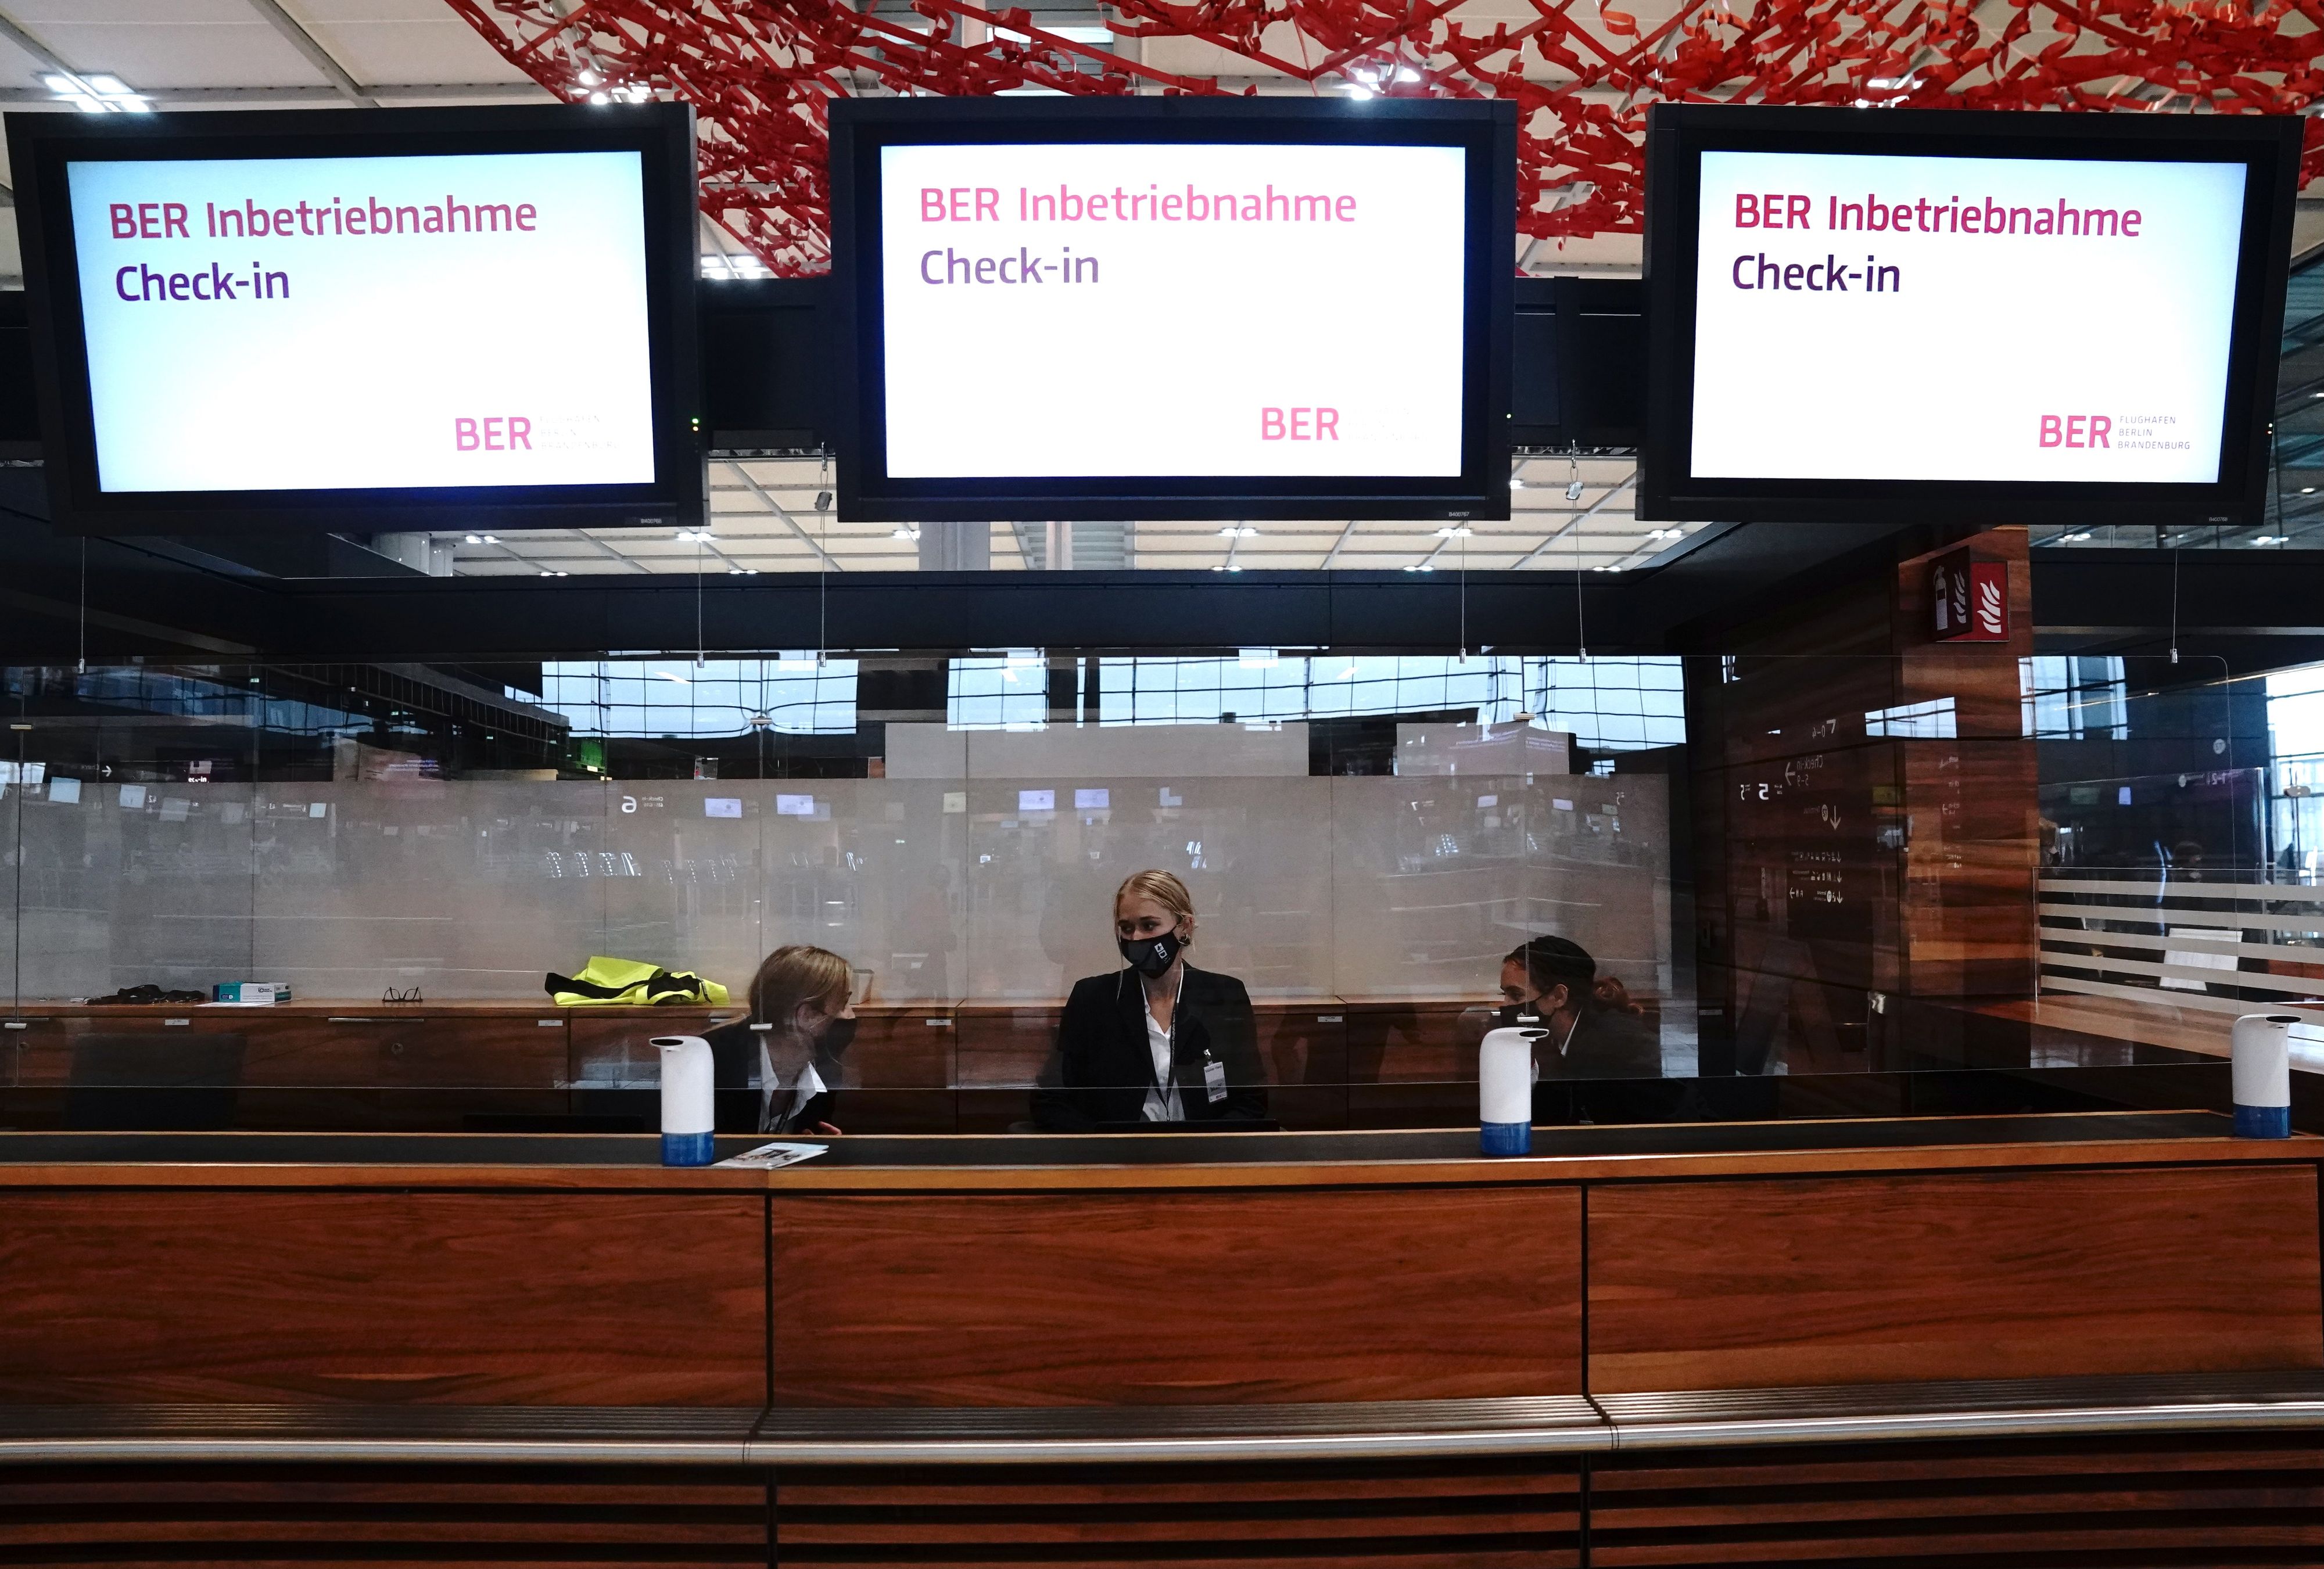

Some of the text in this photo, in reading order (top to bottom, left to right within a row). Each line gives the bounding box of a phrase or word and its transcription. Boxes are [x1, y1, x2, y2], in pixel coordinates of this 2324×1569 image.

[110, 195, 536, 239] BER Inbetriebnahme
[921, 184, 1356, 222] BER Inbetriebnahme
[1735, 193, 2142, 237] BER Inbetriebnahme
[116, 261, 289, 301] Check-in
[921, 246, 1099, 285] Check-in
[1733, 253, 1900, 292] Check-in
[456, 417, 532, 451] BER
[1262, 407, 1339, 440] BER
[2039, 415, 2111, 448] BER
[2119, 416, 2176, 424] FLUGHAFEN
[2119, 428, 2152, 436] BERLIN
[2118, 441, 2190, 450] BRANDENBURG
